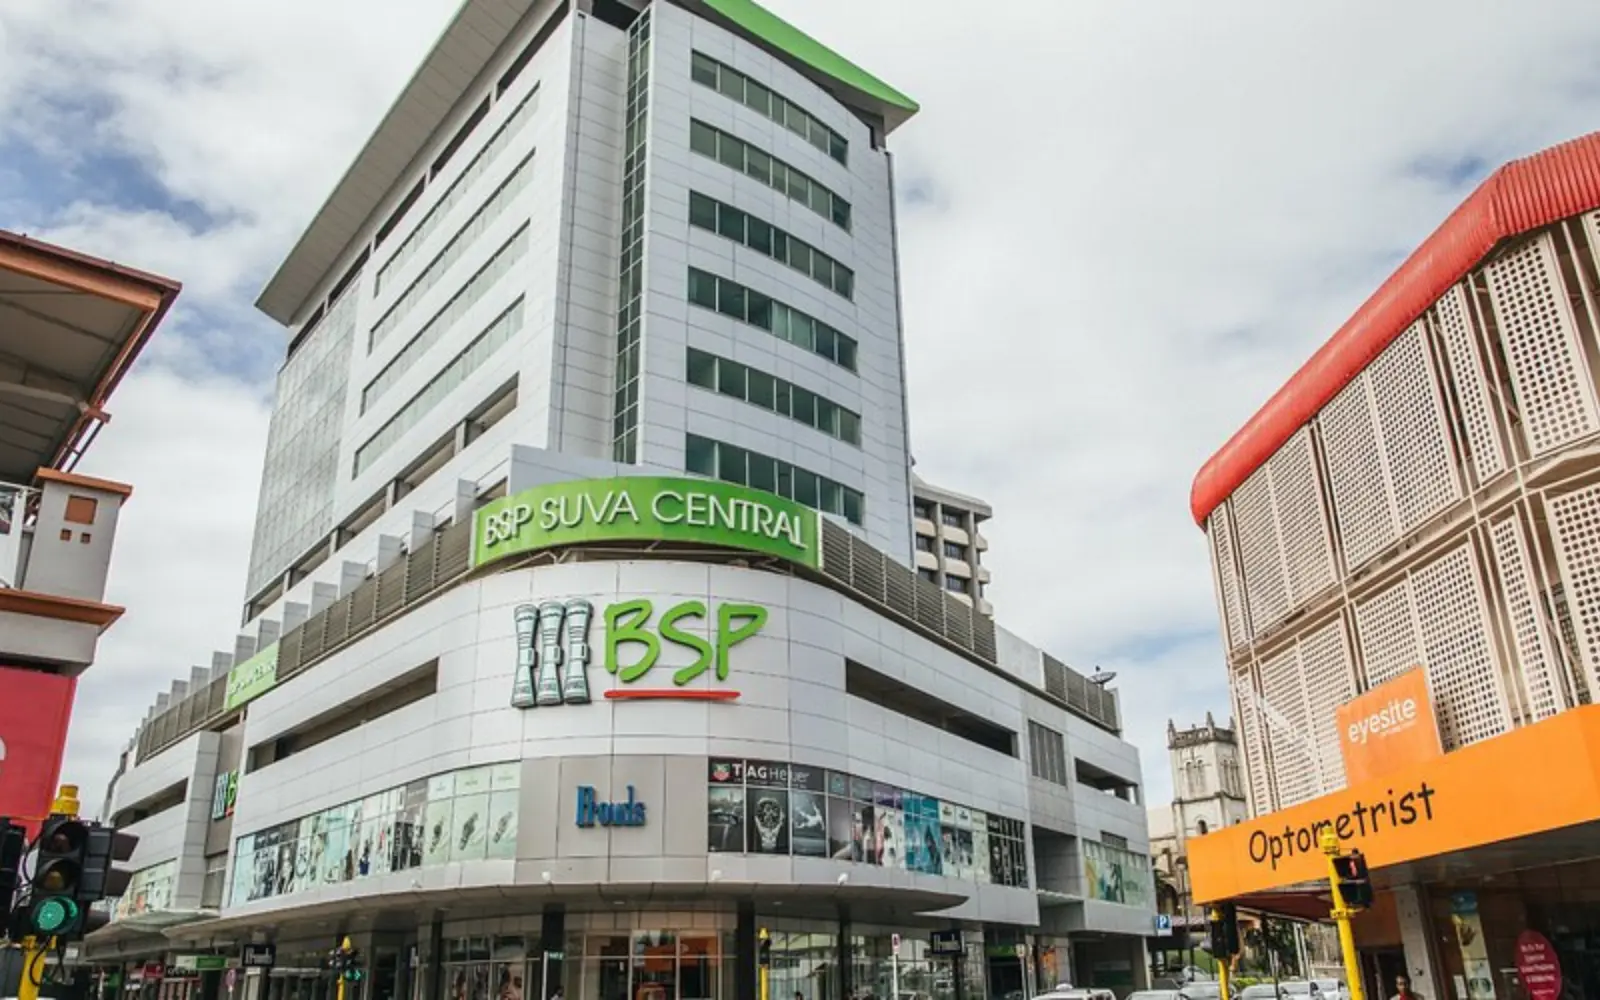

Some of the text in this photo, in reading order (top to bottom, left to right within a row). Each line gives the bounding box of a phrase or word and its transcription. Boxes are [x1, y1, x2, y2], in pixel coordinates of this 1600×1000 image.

[484, 490, 808, 550] BSP SUVA CENTRAL
[604, 599, 767, 686] BSP
[1348, 698, 1416, 745] eyesite
[732, 763, 767, 780] TAG
[1249, 782, 1434, 871] Optometrist
